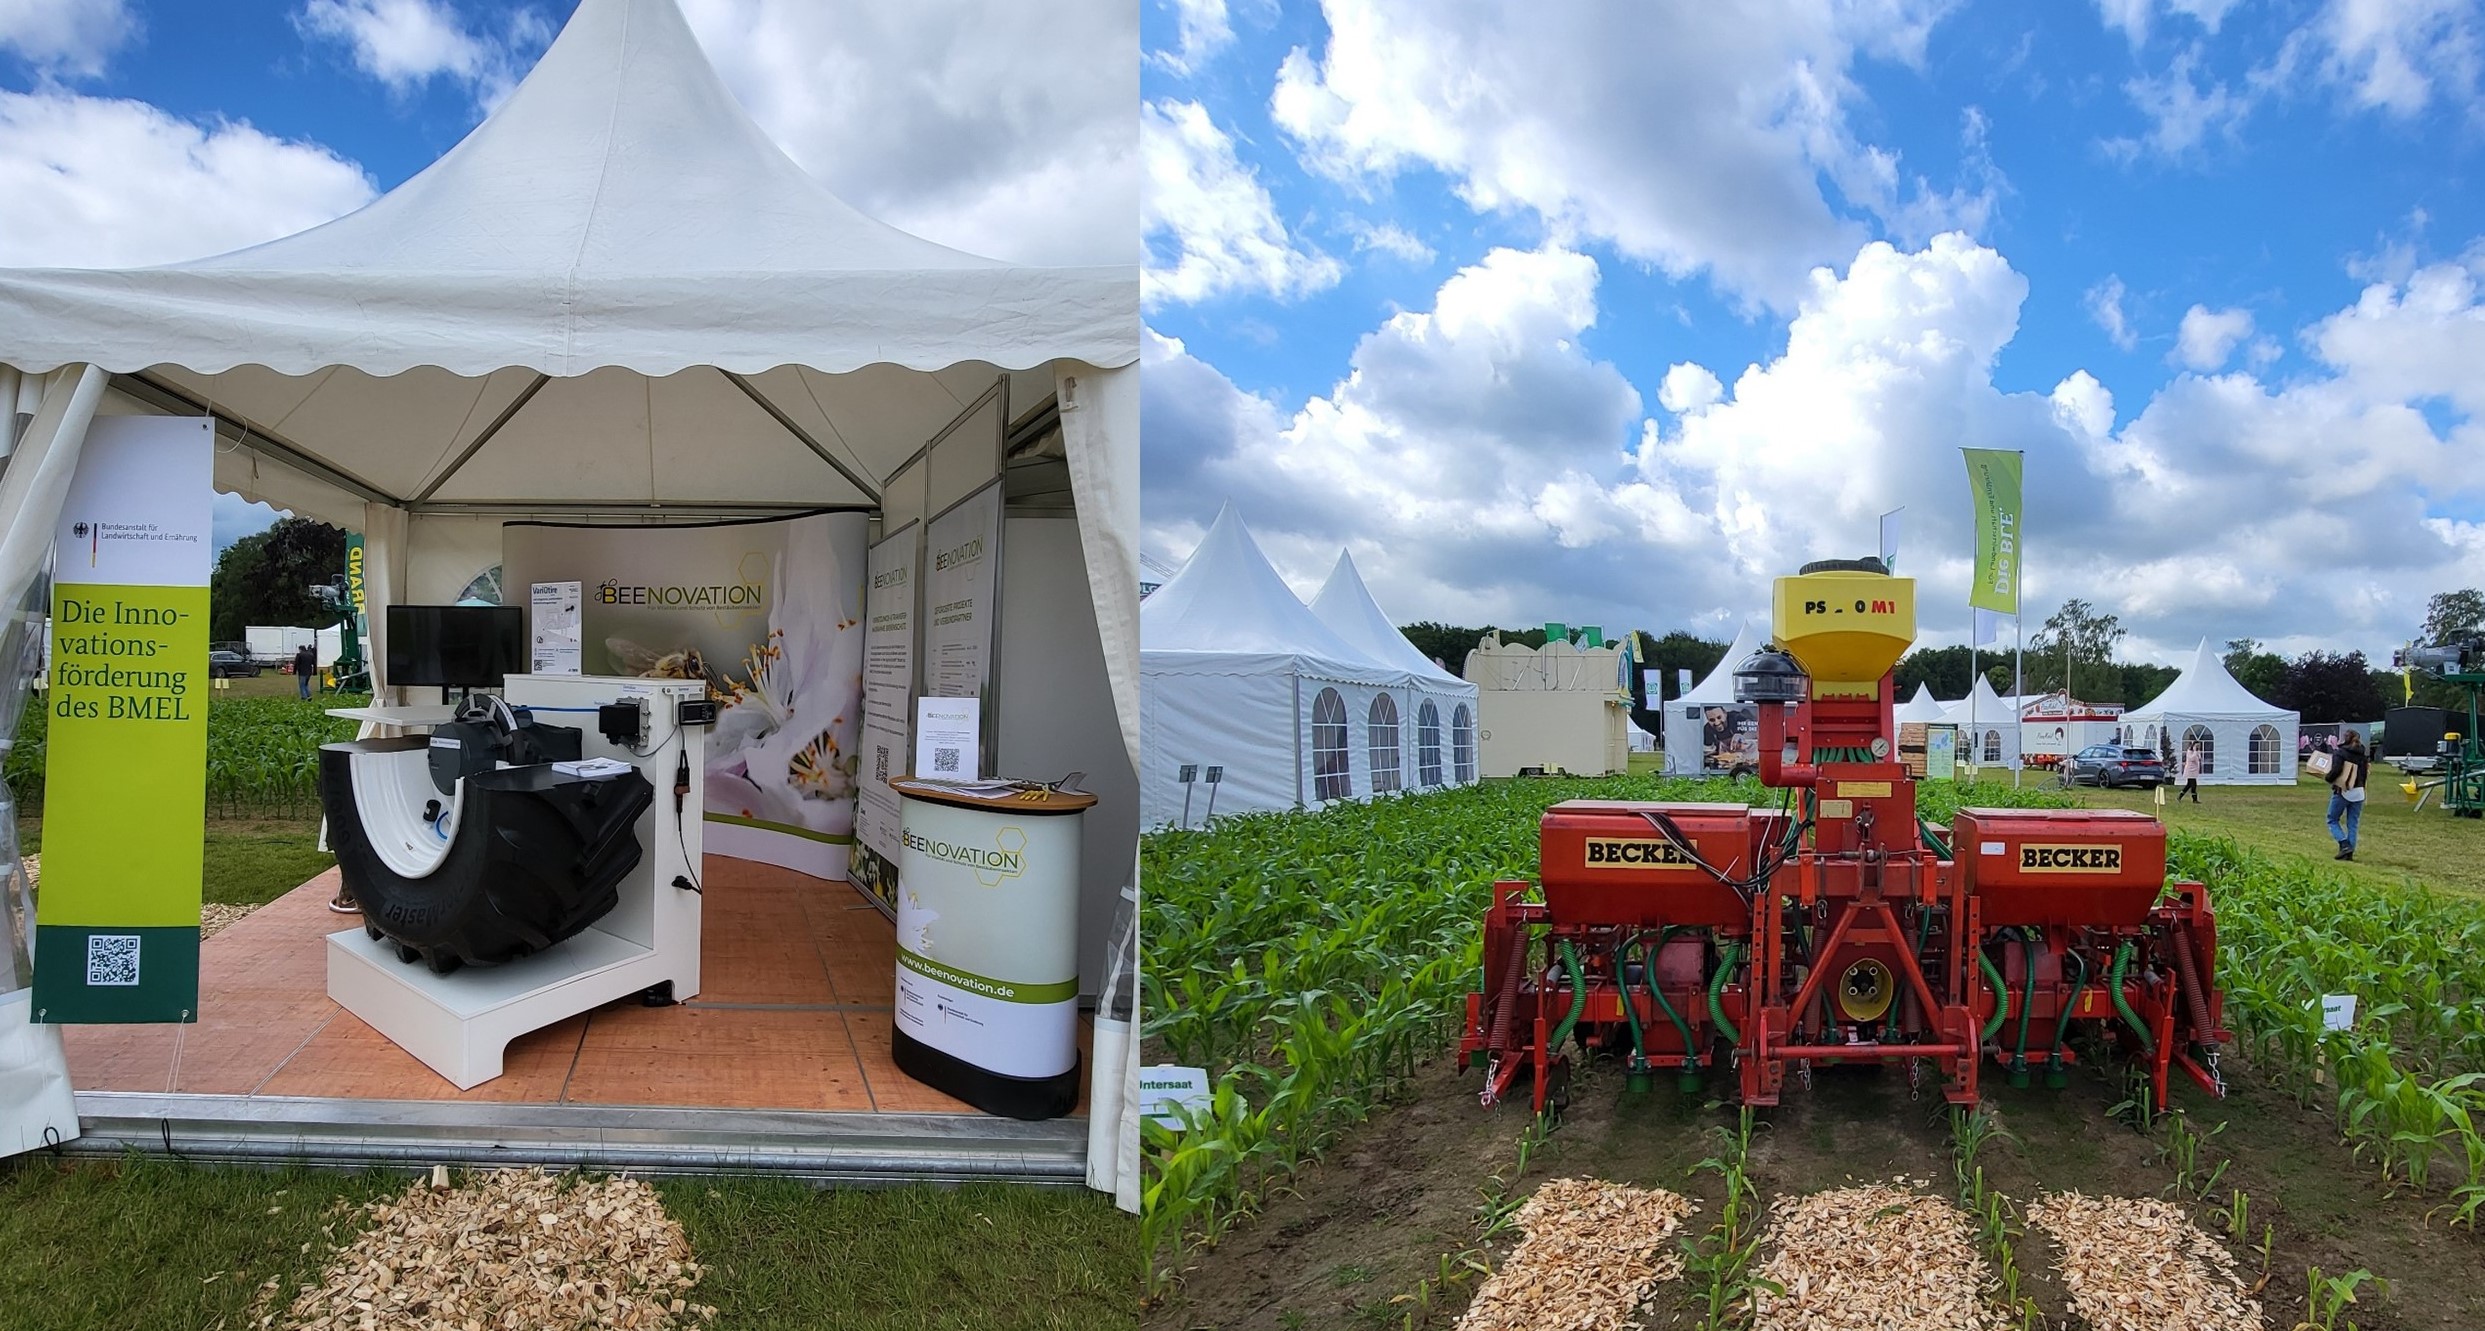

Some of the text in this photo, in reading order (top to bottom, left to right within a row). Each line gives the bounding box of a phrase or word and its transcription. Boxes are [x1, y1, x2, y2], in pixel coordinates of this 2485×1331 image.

[101, 523, 158, 531] Bundesanstalt für
[101, 532, 198, 543] Landwirtschaft und Ernährung
[936, 536, 984, 571] BEENOVATION
[602, 585, 761, 605] BEENOVATION
[61, 600, 189, 626] Die Inno-
[1805, 601, 1826, 615] PS
[1871, 601, 1895, 614] M1
[59, 632, 168, 656] vations-
[57, 662, 188, 695] förderung
[56, 694, 190, 720] des BMEL
[902, 832, 1018, 869] BEENOVATION
[2022, 848, 2120, 868] BECKER
[901, 953, 1015, 998] www.beenovation.de
